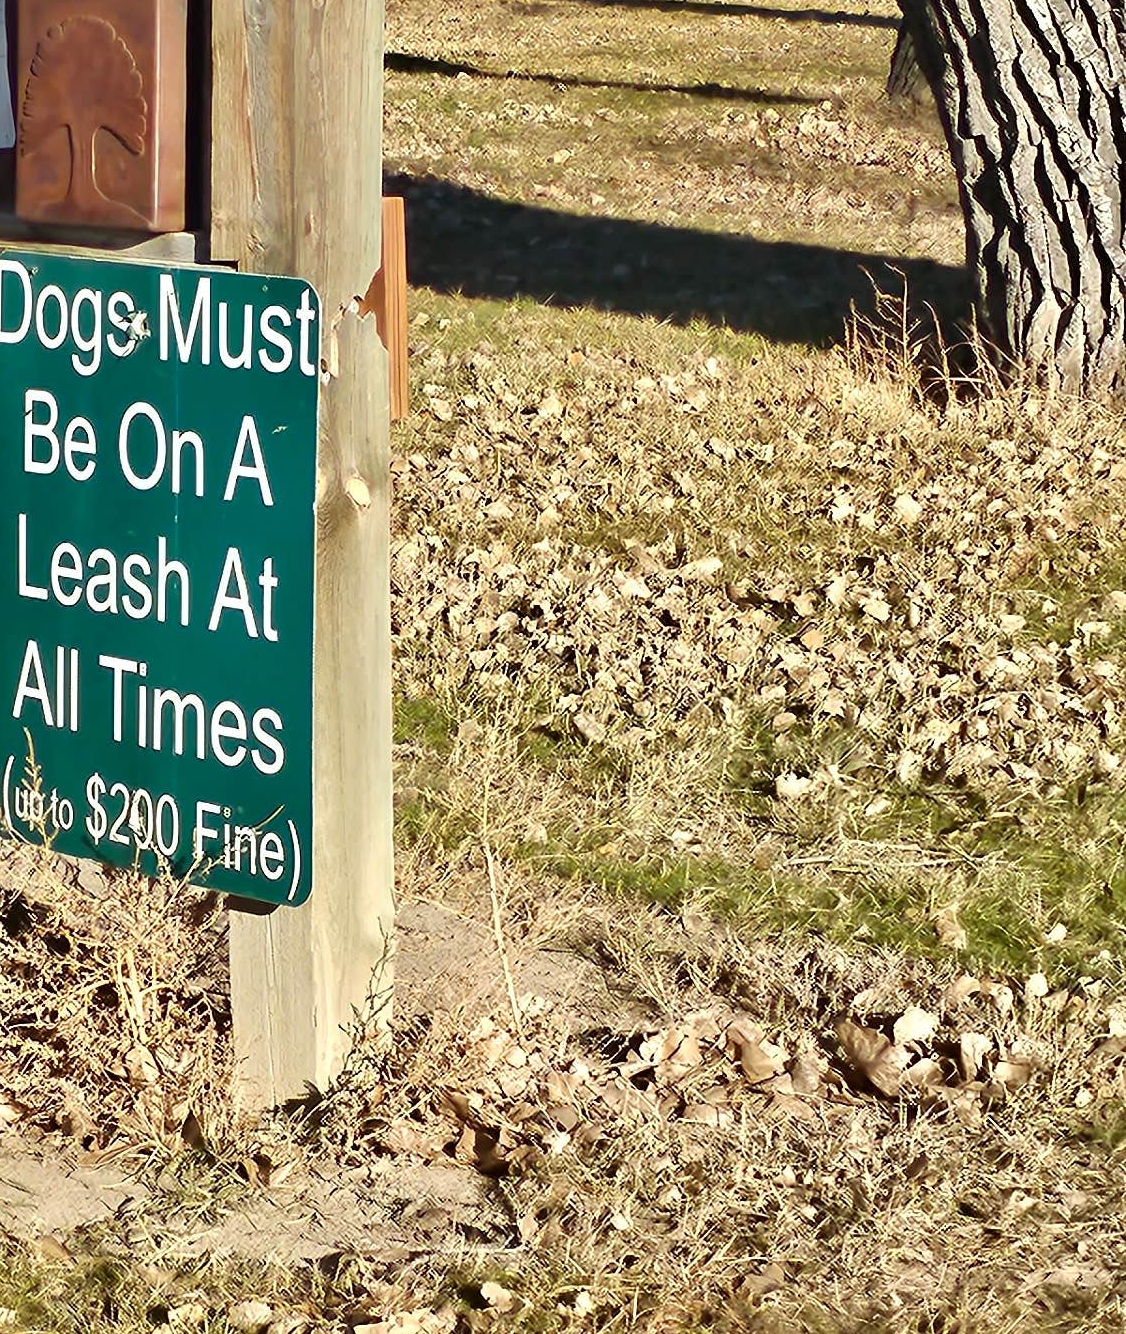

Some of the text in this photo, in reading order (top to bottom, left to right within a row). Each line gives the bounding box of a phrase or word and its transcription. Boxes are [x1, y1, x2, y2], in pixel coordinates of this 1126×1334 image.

[159, 273, 316, 377] Must
[24, 387, 274, 507] Be On A
[17, 513, 279, 642] Leash At
[12, 639, 286, 776] All Times
[2, 754, 303, 901] (up to $200 Fine)
